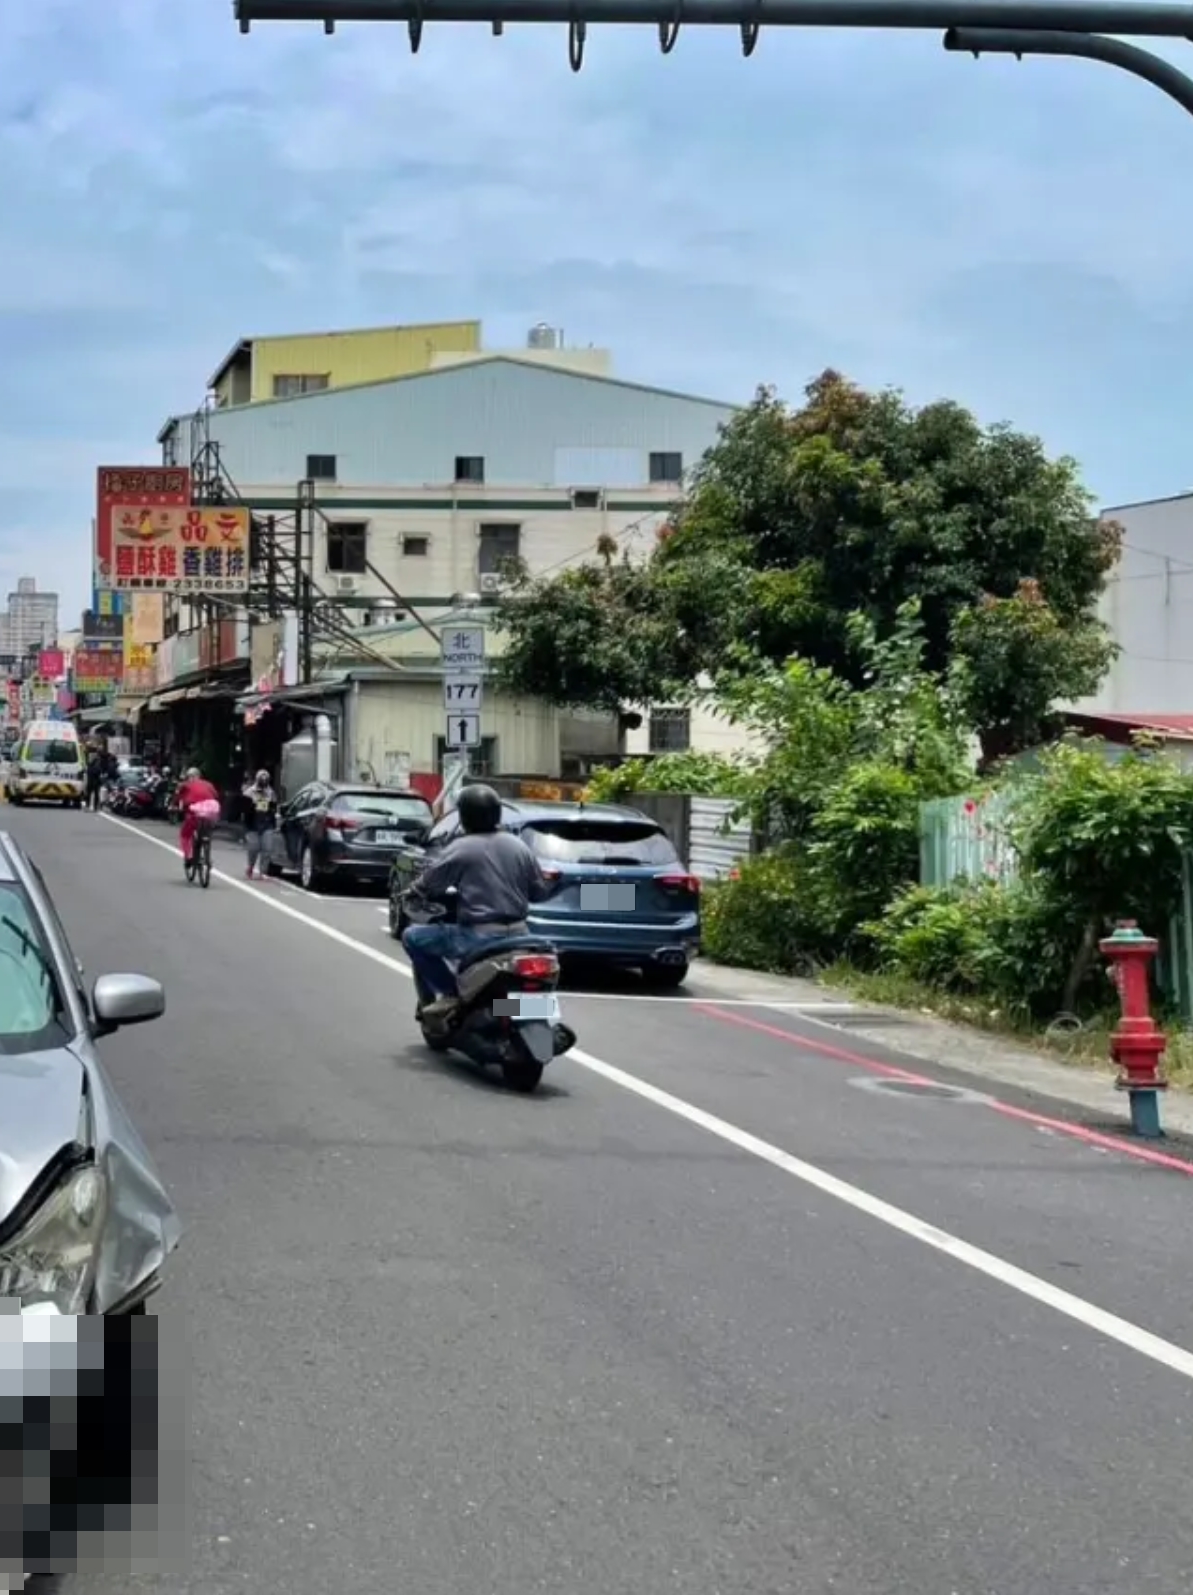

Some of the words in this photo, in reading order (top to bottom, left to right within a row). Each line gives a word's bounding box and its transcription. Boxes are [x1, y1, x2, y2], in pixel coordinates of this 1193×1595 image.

[173, 579, 244, 589] 2338653
[453, 633, 470, 649] 北
[444, 653, 482, 664] NORTH
[447, 684, 478, 700] 177
